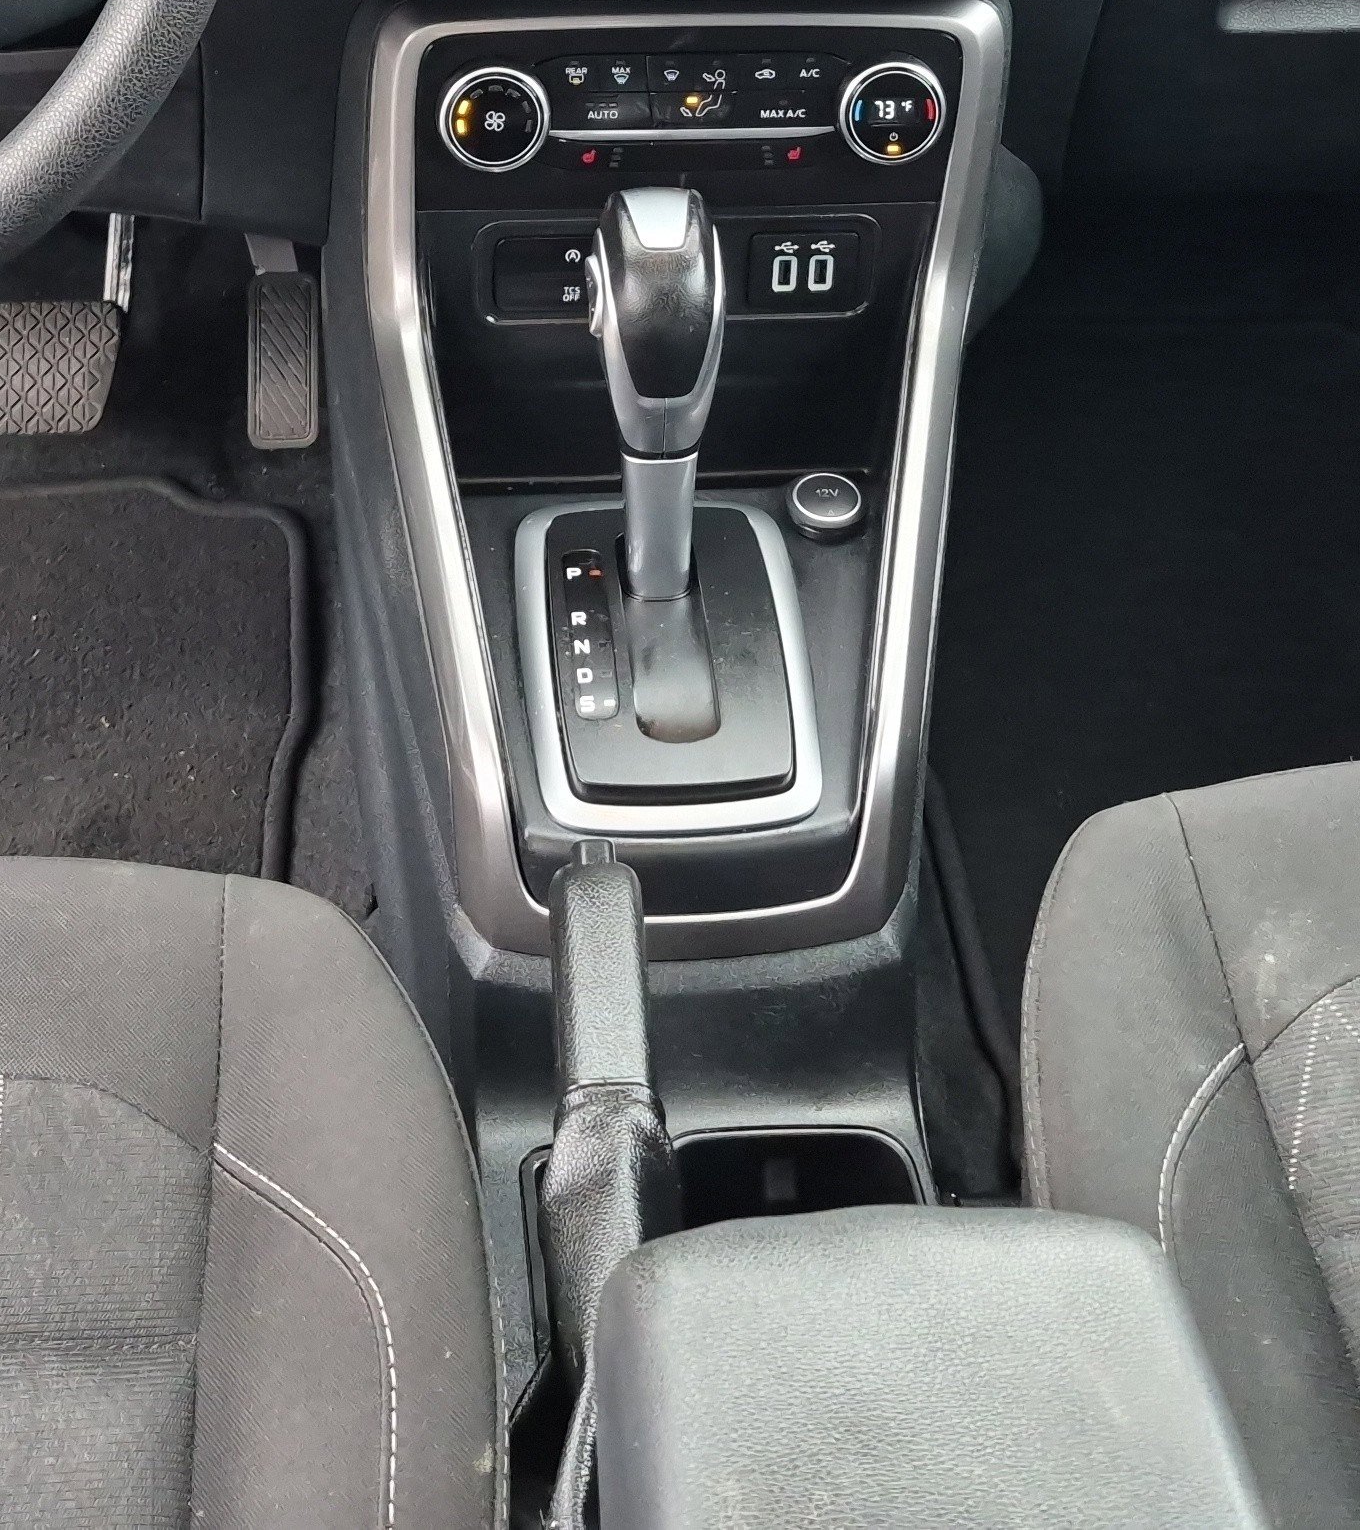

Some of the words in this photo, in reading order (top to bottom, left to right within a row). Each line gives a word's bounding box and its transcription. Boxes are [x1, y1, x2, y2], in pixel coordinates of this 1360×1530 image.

[565, 67, 588, 75] REAR
[800, 68, 820, 79] A/C
[587, 110, 618, 120] AUTO
[761, 109, 785, 118] MAX
[786, 108, 807, 119] A/C
[563, 286, 580, 294] TCS
[562, 294, 580, 302] OFF
[815, 488, 839, 498] 12V
[566, 567, 582, 580] P
[570, 611, 587, 626] R
[573, 638, 590, 655] N
[576, 667, 593, 683] D
[579, 695, 596, 713] S
